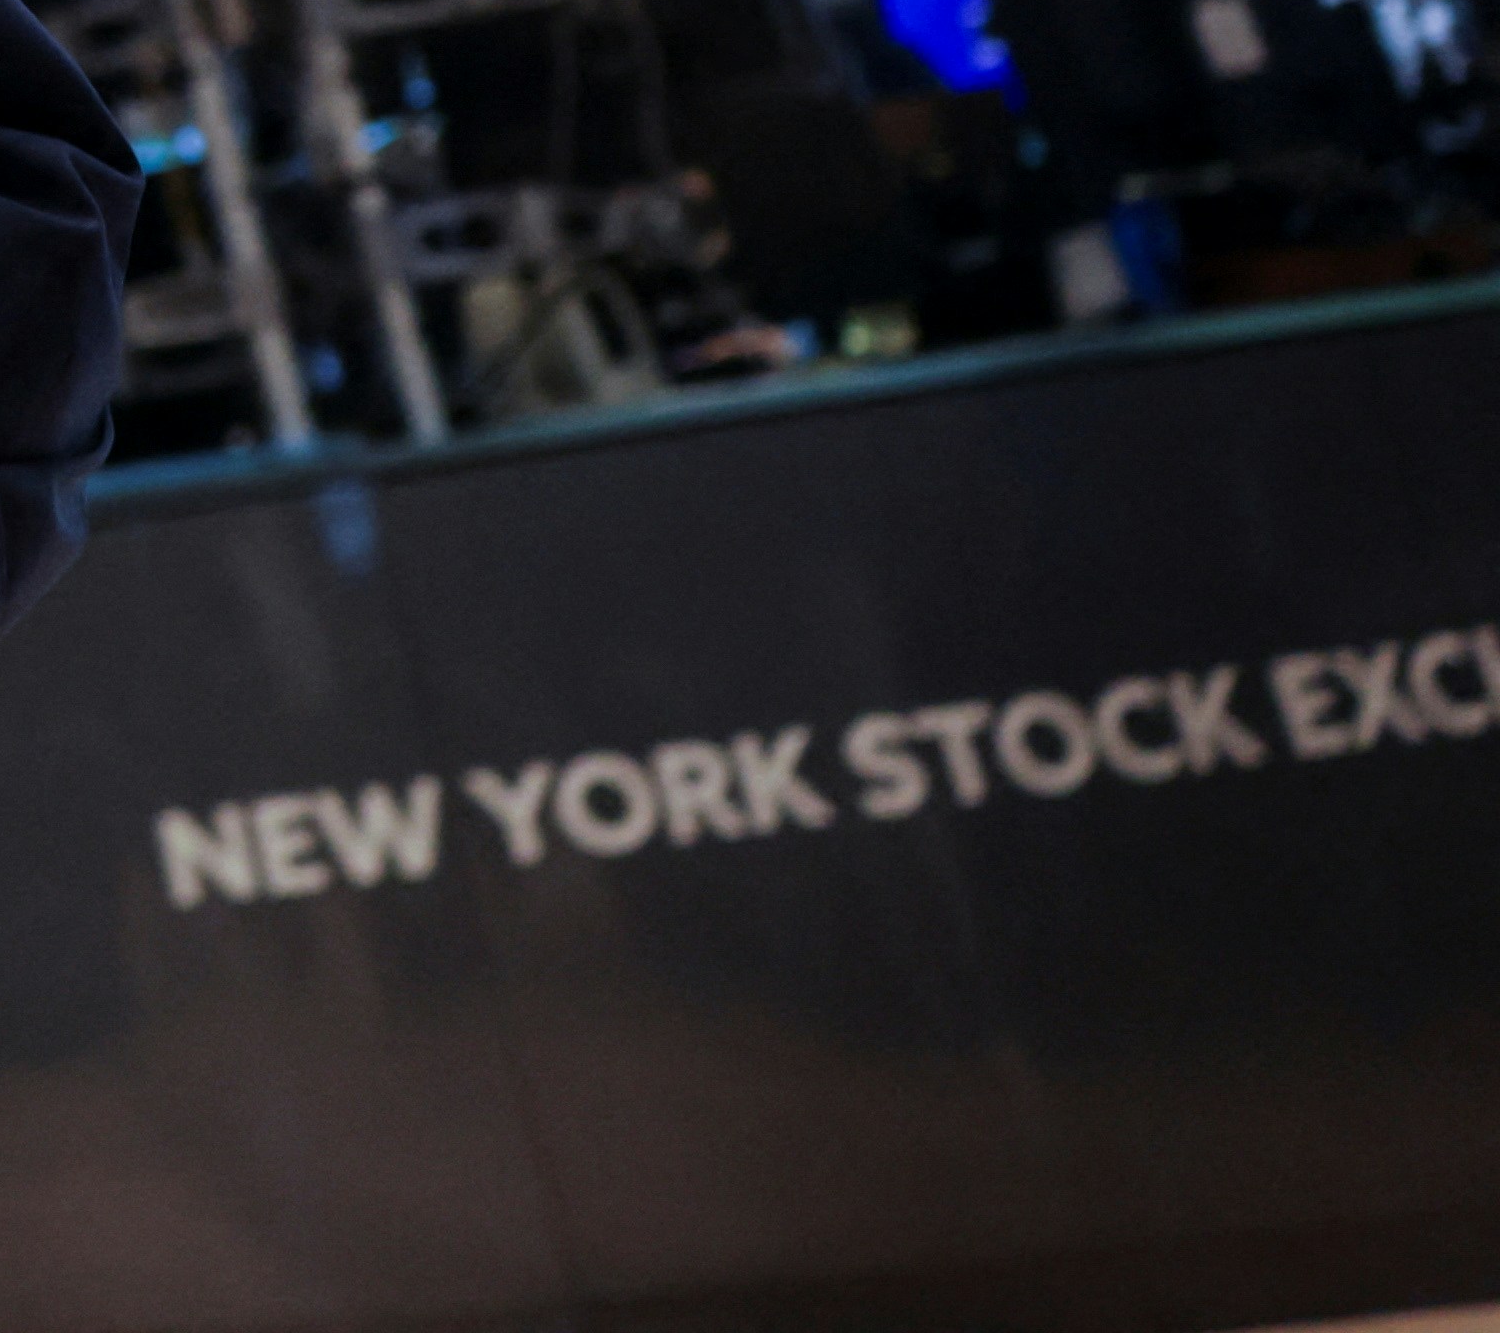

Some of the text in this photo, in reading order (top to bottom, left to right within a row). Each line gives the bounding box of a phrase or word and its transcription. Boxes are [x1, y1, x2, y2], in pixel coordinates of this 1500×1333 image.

[158, 773, 444, 912] NEW
[460, 724, 837, 869] YORK
[841, 663, 1266, 819] STOCK
